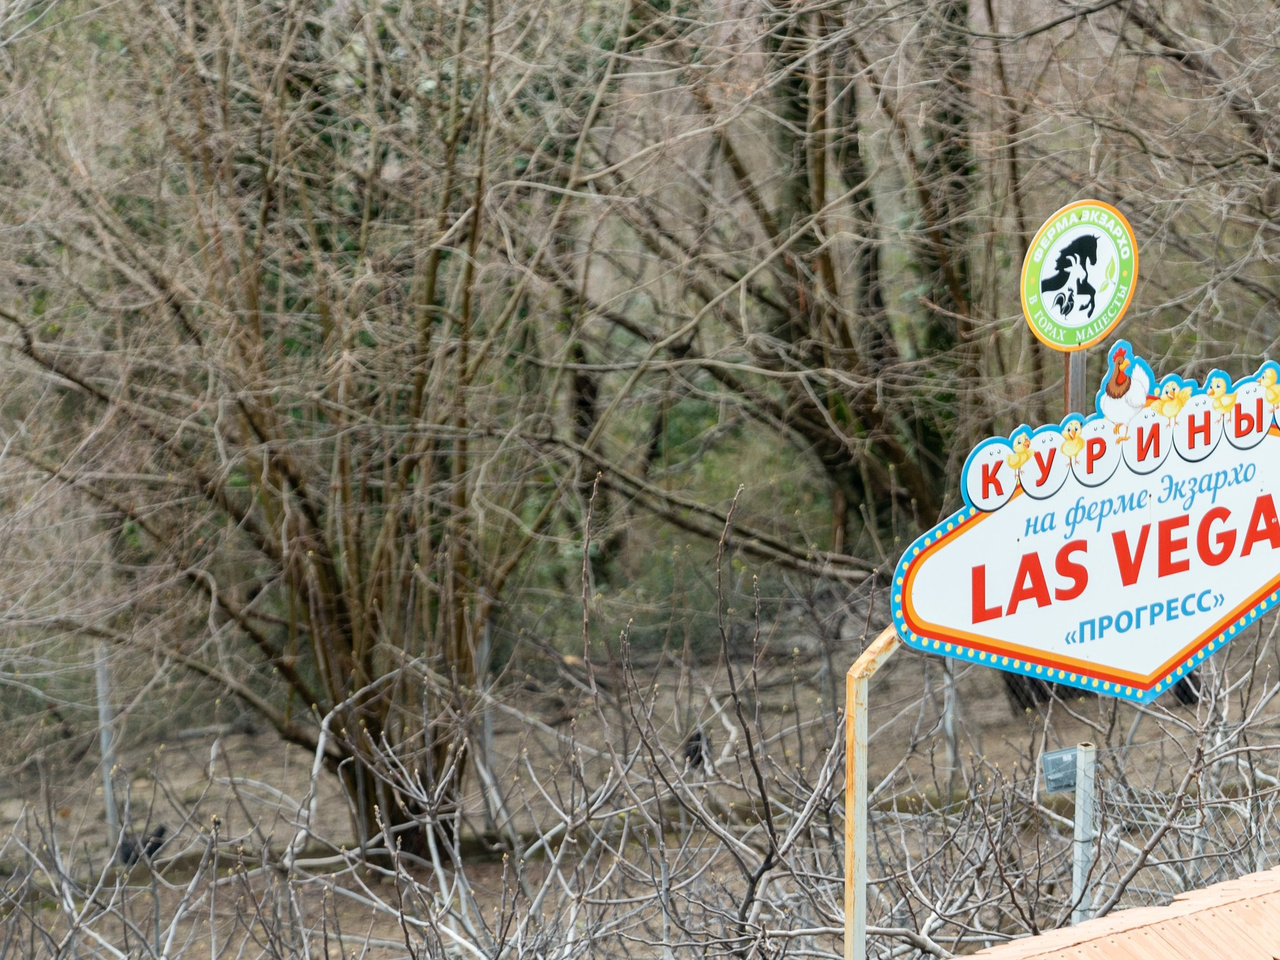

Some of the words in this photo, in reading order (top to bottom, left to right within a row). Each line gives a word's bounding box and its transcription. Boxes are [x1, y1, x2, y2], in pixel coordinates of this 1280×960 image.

[1033, 213, 1079, 264] ФЕРМА
[1080, 209, 1131, 260] ЭКЗАРХО
[1028, 294, 1038, 305] В
[1034, 310, 1067, 342] ГОРАХ
[1075, 284, 1128, 342] МАЦЕСТЫ
[1023, 511, 1057, 538] на
[1063, 486, 1149, 540] ферме
[1156, 462, 1257, 505] Экзархо
[970, 538, 1089, 625] LAS
[1064, 588, 1226, 646] «ПРОГРЕСС»
